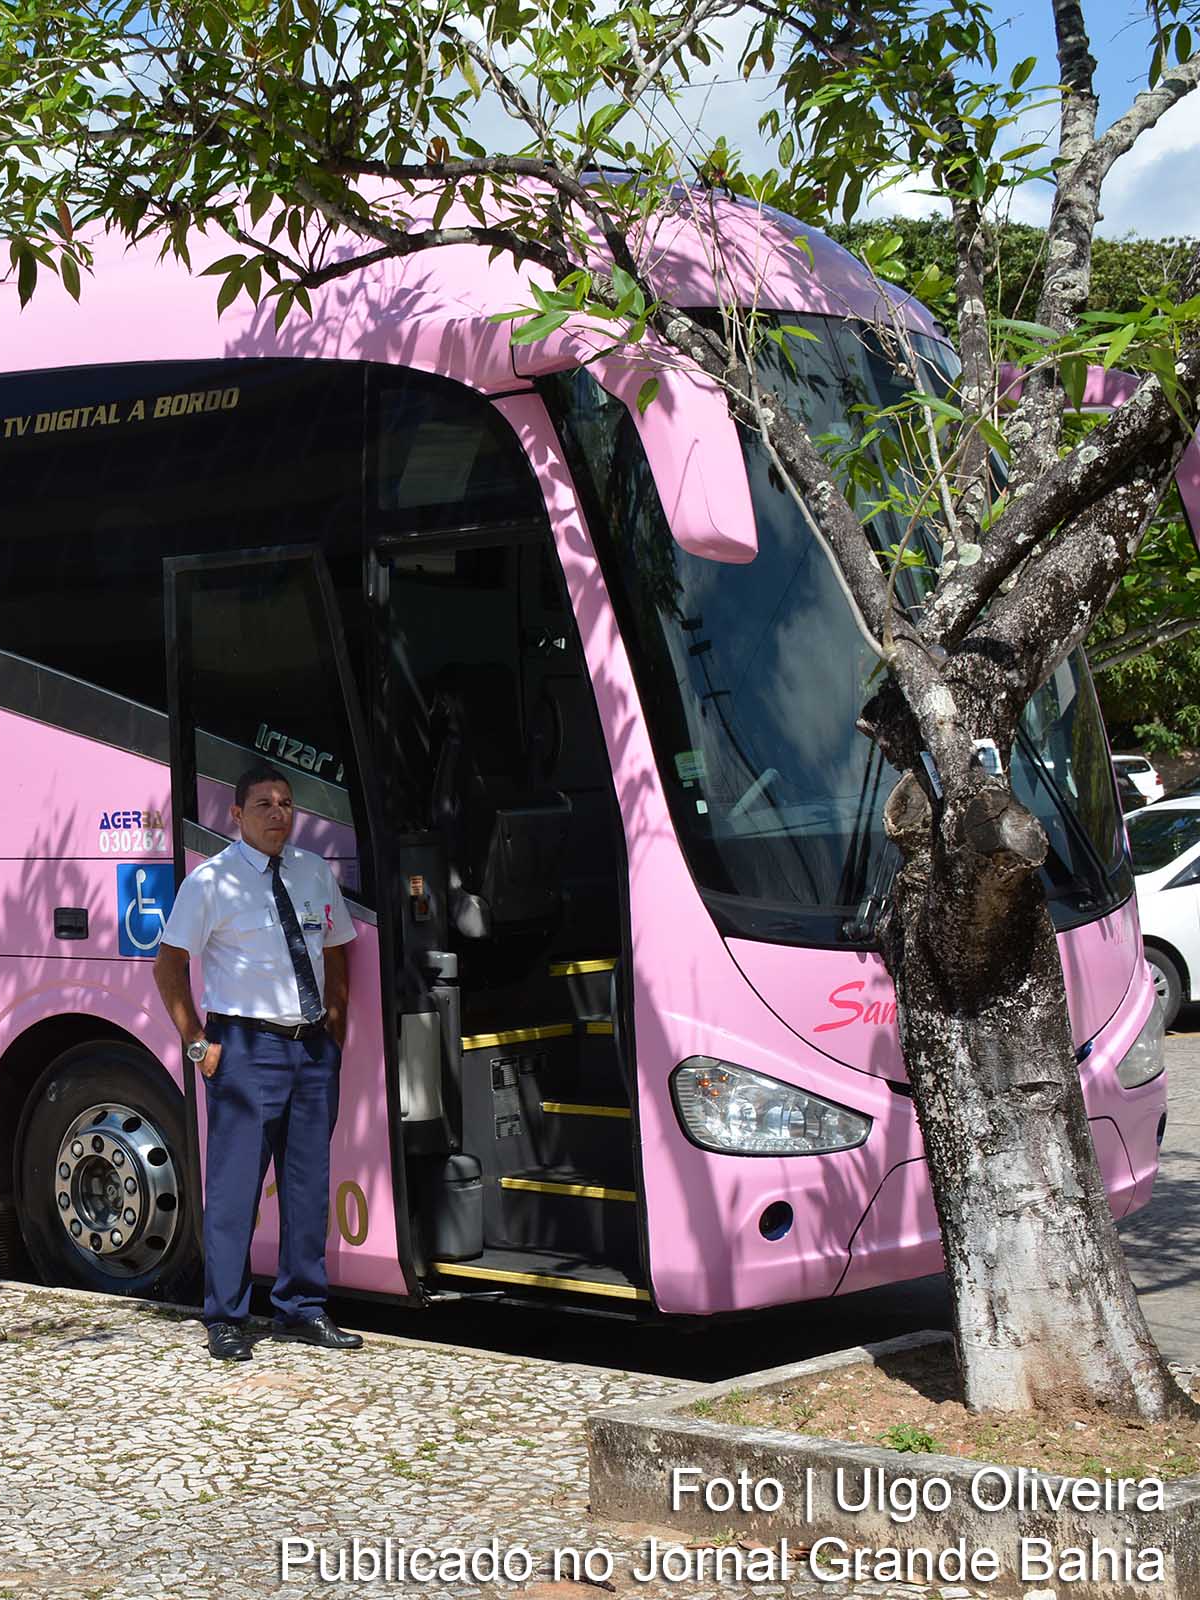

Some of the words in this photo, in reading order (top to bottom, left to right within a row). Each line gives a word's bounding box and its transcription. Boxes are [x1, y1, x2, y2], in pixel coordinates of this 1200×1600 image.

[4, 416, 31, 438] TV
[34, 403, 120, 434] DIGITAL
[127, 399, 145, 422] A
[153, 387, 240, 419] BORDO
[255, 722, 334, 773] Irizar
[99, 810, 164, 830] AGERBA
[99, 830, 168, 853] 030262
